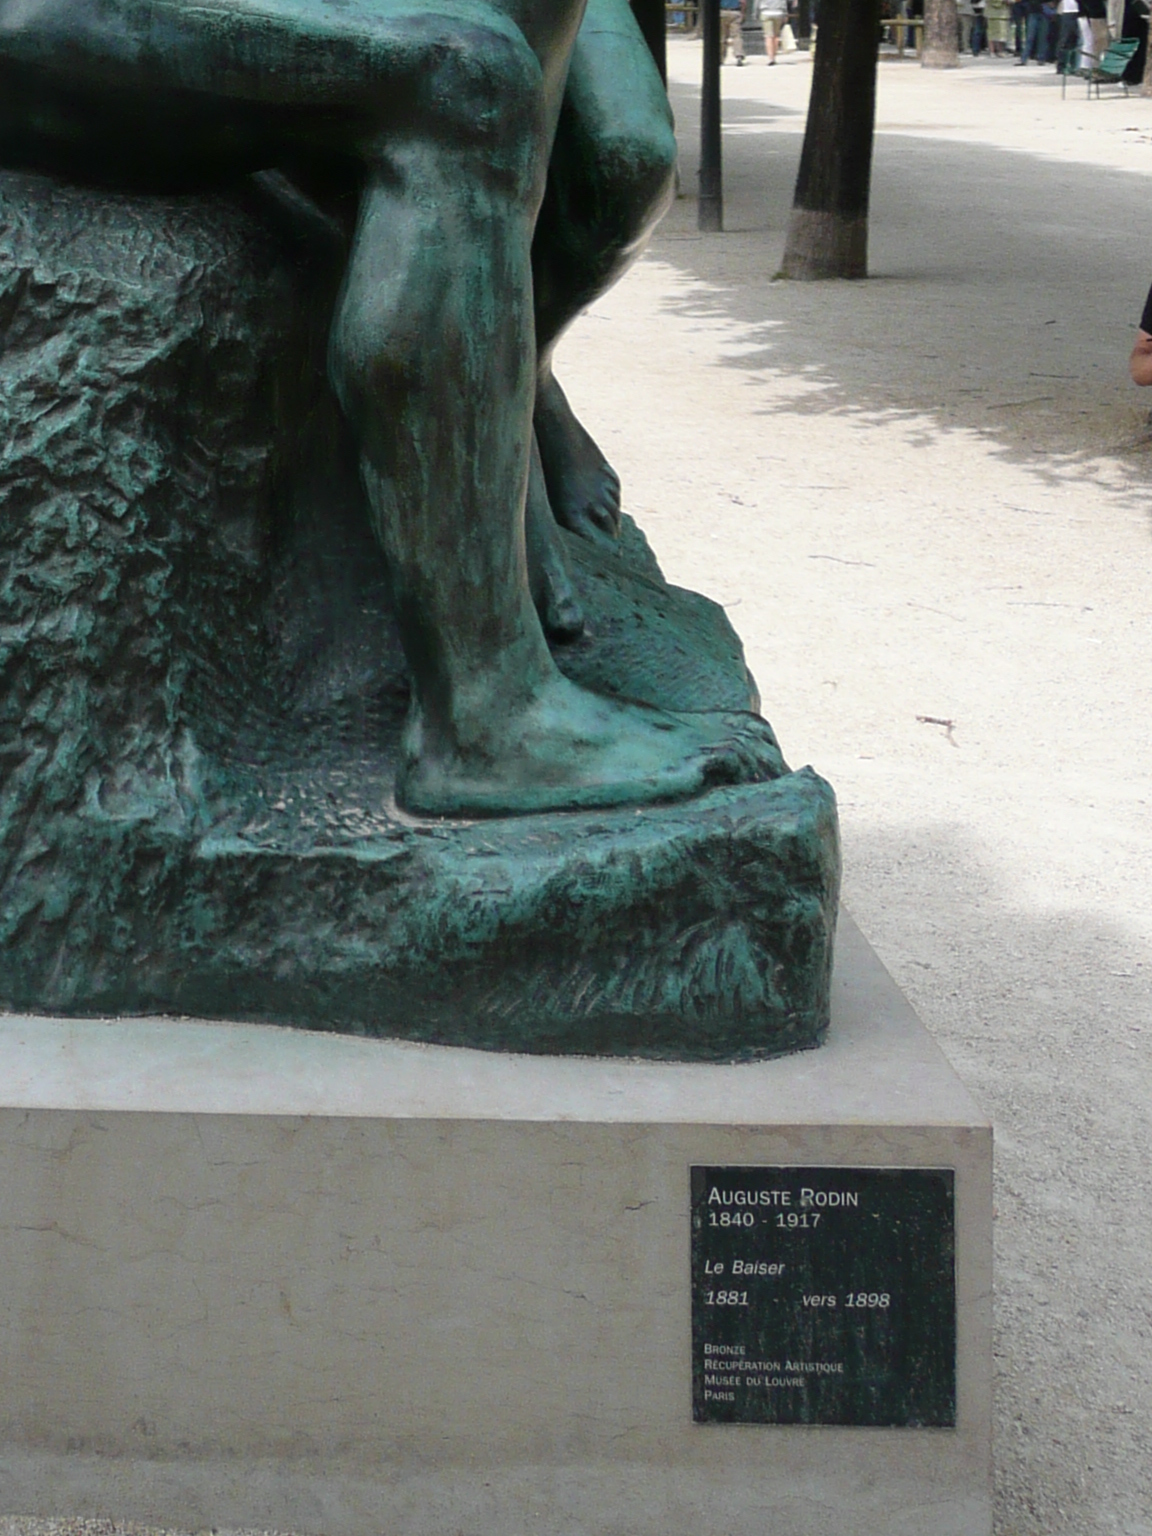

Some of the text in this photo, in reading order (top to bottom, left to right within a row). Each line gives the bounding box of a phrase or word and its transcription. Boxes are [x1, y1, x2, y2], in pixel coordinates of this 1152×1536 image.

[708, 1186, 858, 1206] AUGUSTE RODIN
[708, 1212, 754, 1227] 1840
[776, 1213, 821, 1228] 1917
[704, 1260, 785, 1275] Le Baiser
[705, 1291, 749, 1305] 1881
[802, 1295, 837, 1306] vers
[845, 1293, 890, 1308] 1898
